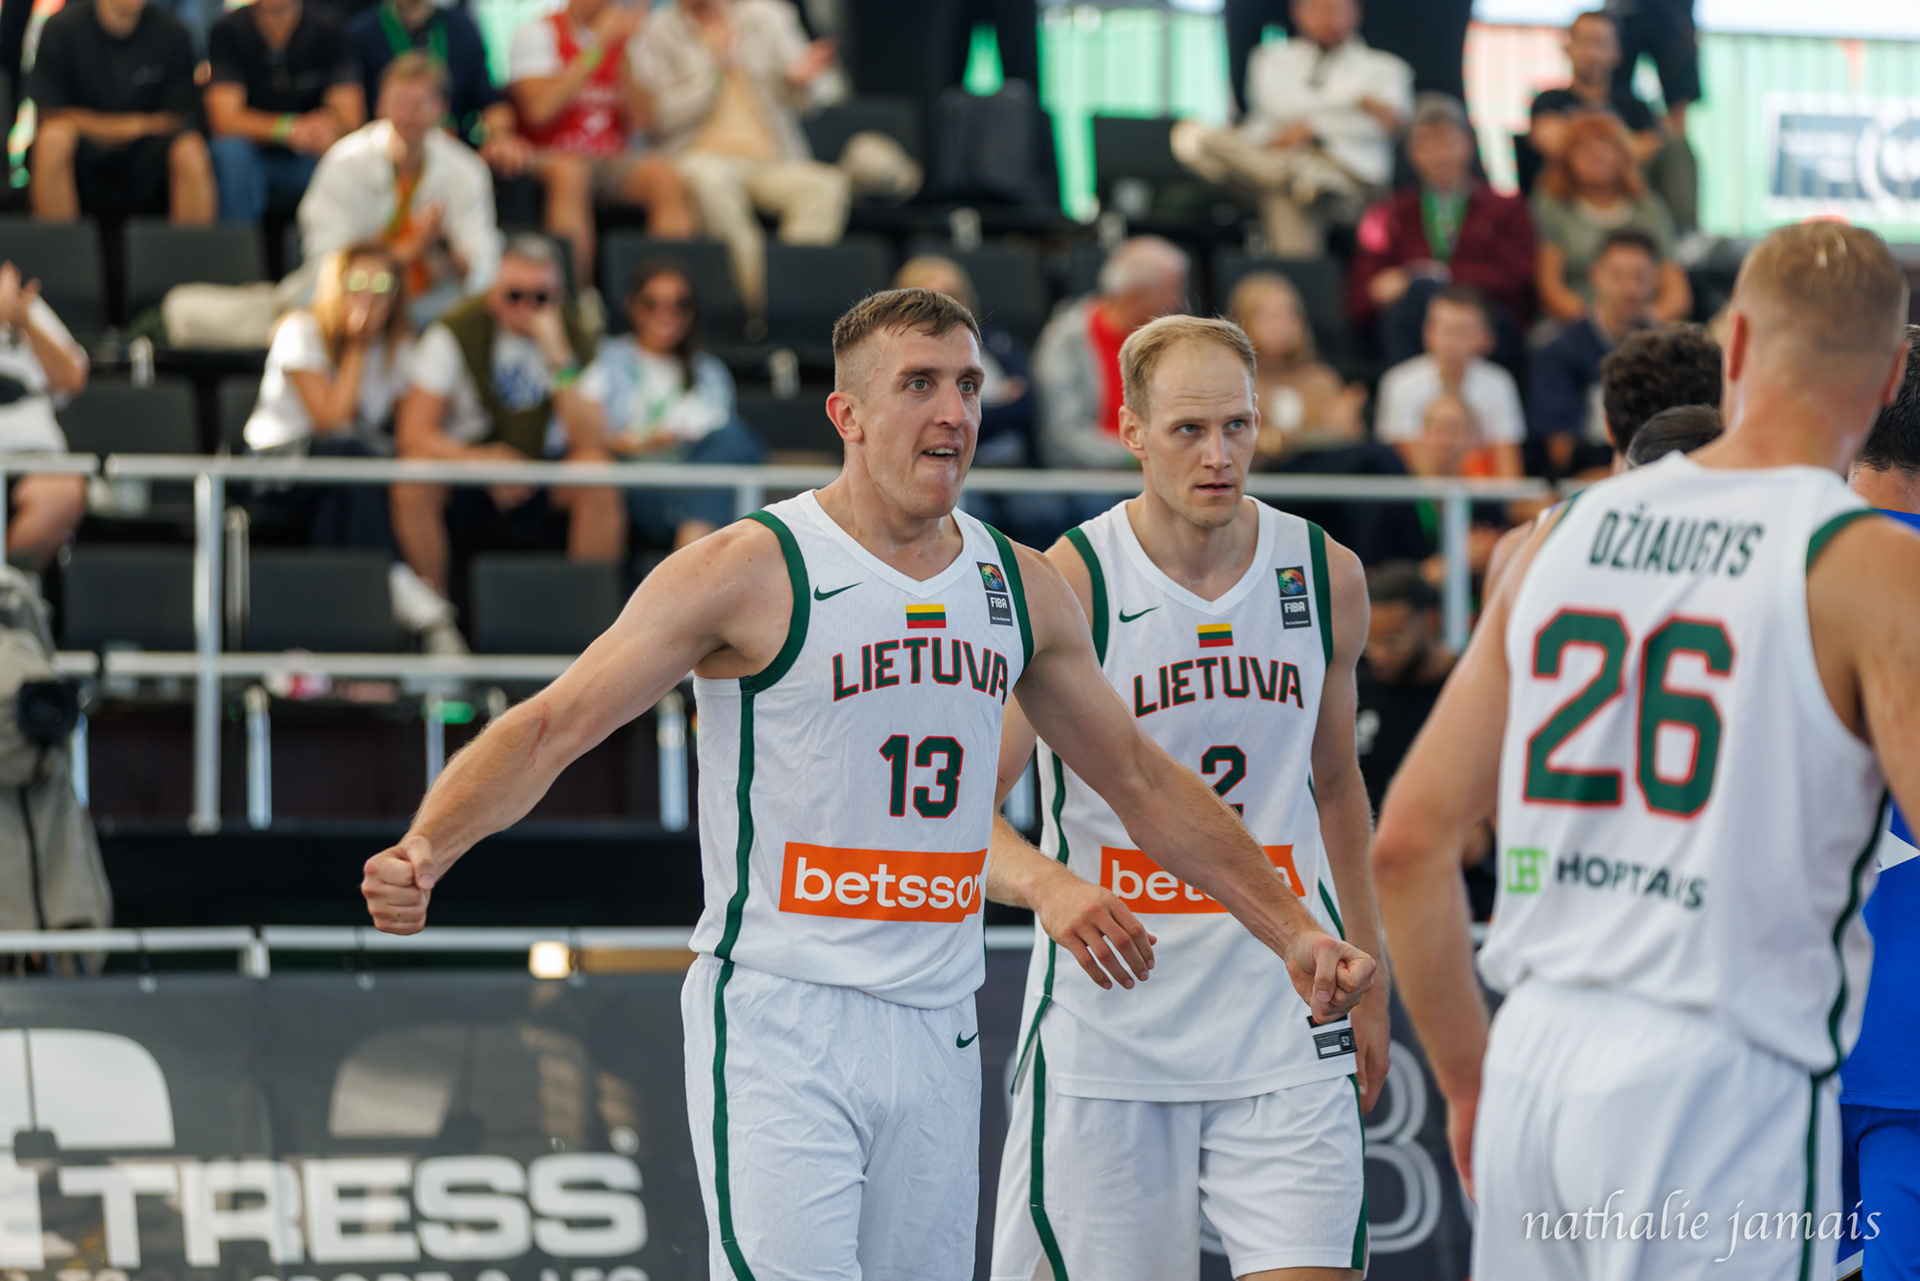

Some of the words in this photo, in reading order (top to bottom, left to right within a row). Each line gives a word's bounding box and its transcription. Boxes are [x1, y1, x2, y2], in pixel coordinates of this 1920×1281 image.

[990, 596, 1008, 609] FIBA
[1284, 601, 1306, 613] FIBA
[832, 637, 1008, 705] LIETUVA
[1134, 656, 1304, 718] LIETUVA
[1522, 607, 1737, 820] 26
[879, 735, 964, 818] 13
[1201, 745, 1246, 817] 2
